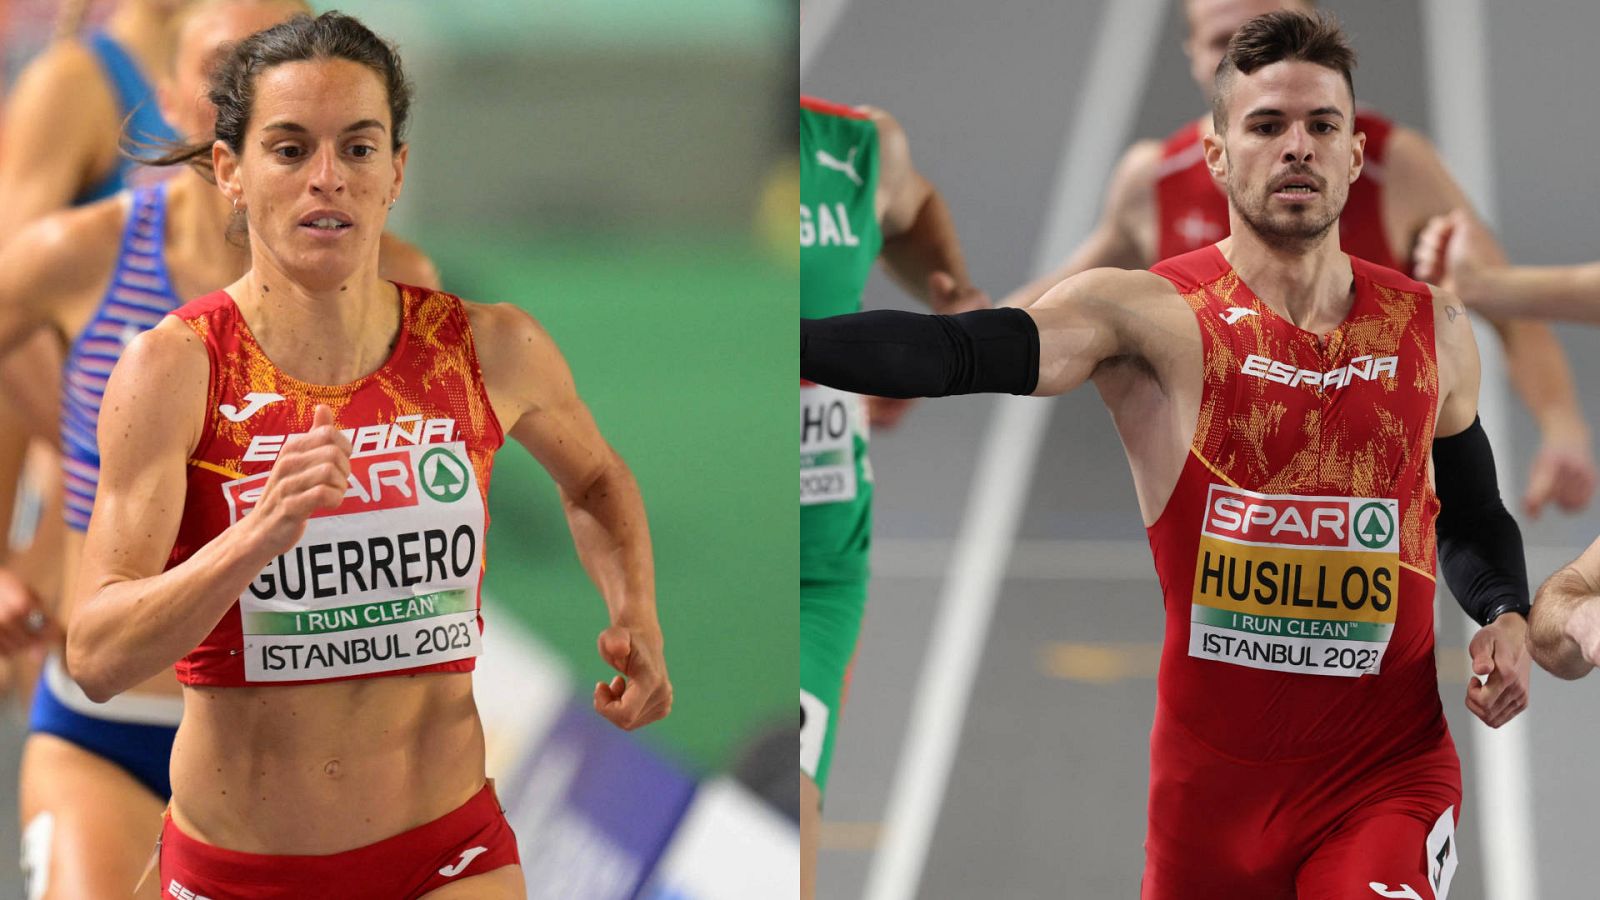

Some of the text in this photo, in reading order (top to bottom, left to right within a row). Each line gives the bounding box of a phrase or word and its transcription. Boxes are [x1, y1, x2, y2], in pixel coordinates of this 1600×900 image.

[1241, 354, 1399, 392] ESPAÑA
[242, 414, 456, 462] EAÑA
[1211, 499, 1346, 540] SPAR
[1200, 551, 1393, 612] HUSILLOS
[296, 614, 302, 632] I
[308, 608, 358, 631] RUN
[1232, 613, 1237, 628] I
[1242, 616, 1281, 633] RUN
[262, 622, 472, 671] ISTANBUL 2023
[1203, 632, 1378, 670] ISTANBUL 2023
